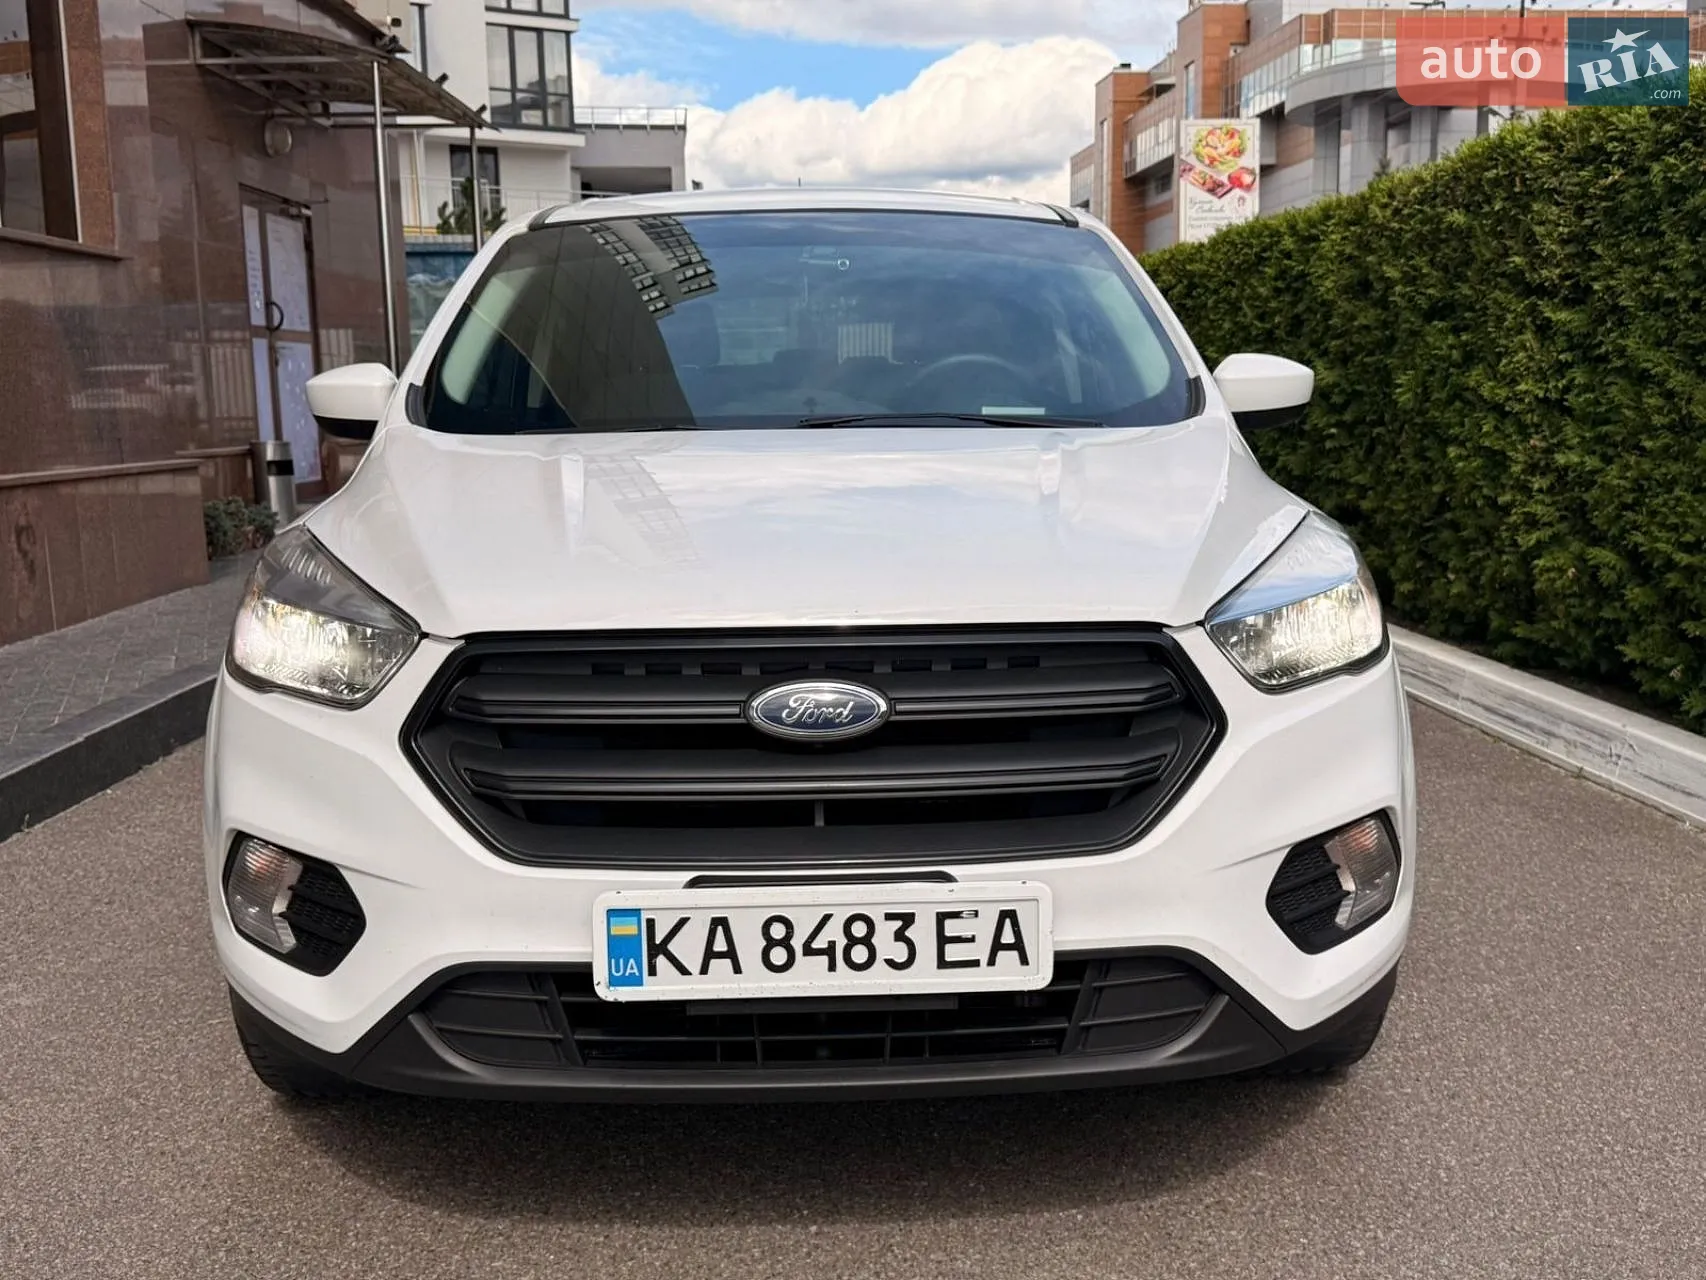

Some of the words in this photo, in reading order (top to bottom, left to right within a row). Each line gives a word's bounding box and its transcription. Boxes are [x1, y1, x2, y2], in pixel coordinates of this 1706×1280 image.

[781, 692, 855, 724] Ford
[646, 915, 743, 976] KA
[761, 912, 918, 974] 8483
[936, 908, 1030, 970] EA
[610, 957, 640, 977] UA
